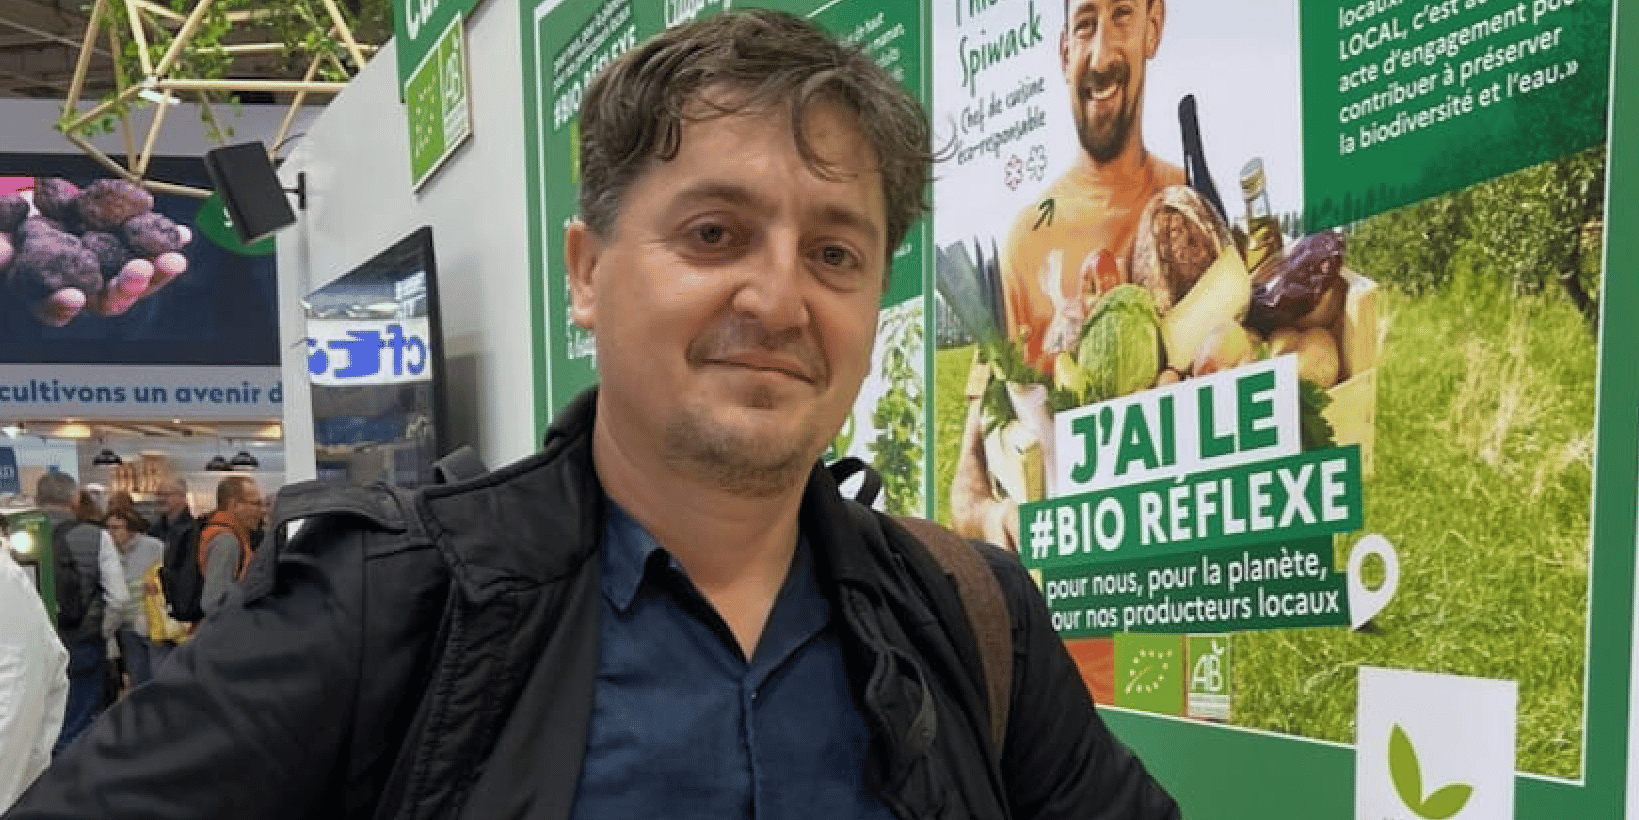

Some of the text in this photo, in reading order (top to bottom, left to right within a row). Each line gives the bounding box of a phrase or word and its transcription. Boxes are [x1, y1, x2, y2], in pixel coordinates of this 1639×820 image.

[959, 0, 1044, 98] Spiwack
[1338, 0, 1577, 93] acte d'engagement po
[1339, 0, 1459, 61] LOCAL, c'est
[1339, 27, 1562, 123] contribuer à préserver
[1339, 133, 1355, 155] la
[1359, 87, 1474, 149] biodiversité
[1478, 82, 1501, 107] et
[0, 379, 127, 404] cultivons
[133, 385, 168, 404] un
[175, 380, 262, 404] avenir
[1069, 369, 1279, 485] J'AI LE
[1029, 459, 1350, 560] #BIO RÉFLEXE
[1047, 546, 1328, 607] pour nous, pour la planète,
[1051, 587, 1339, 634] our nos producteurs locaux
